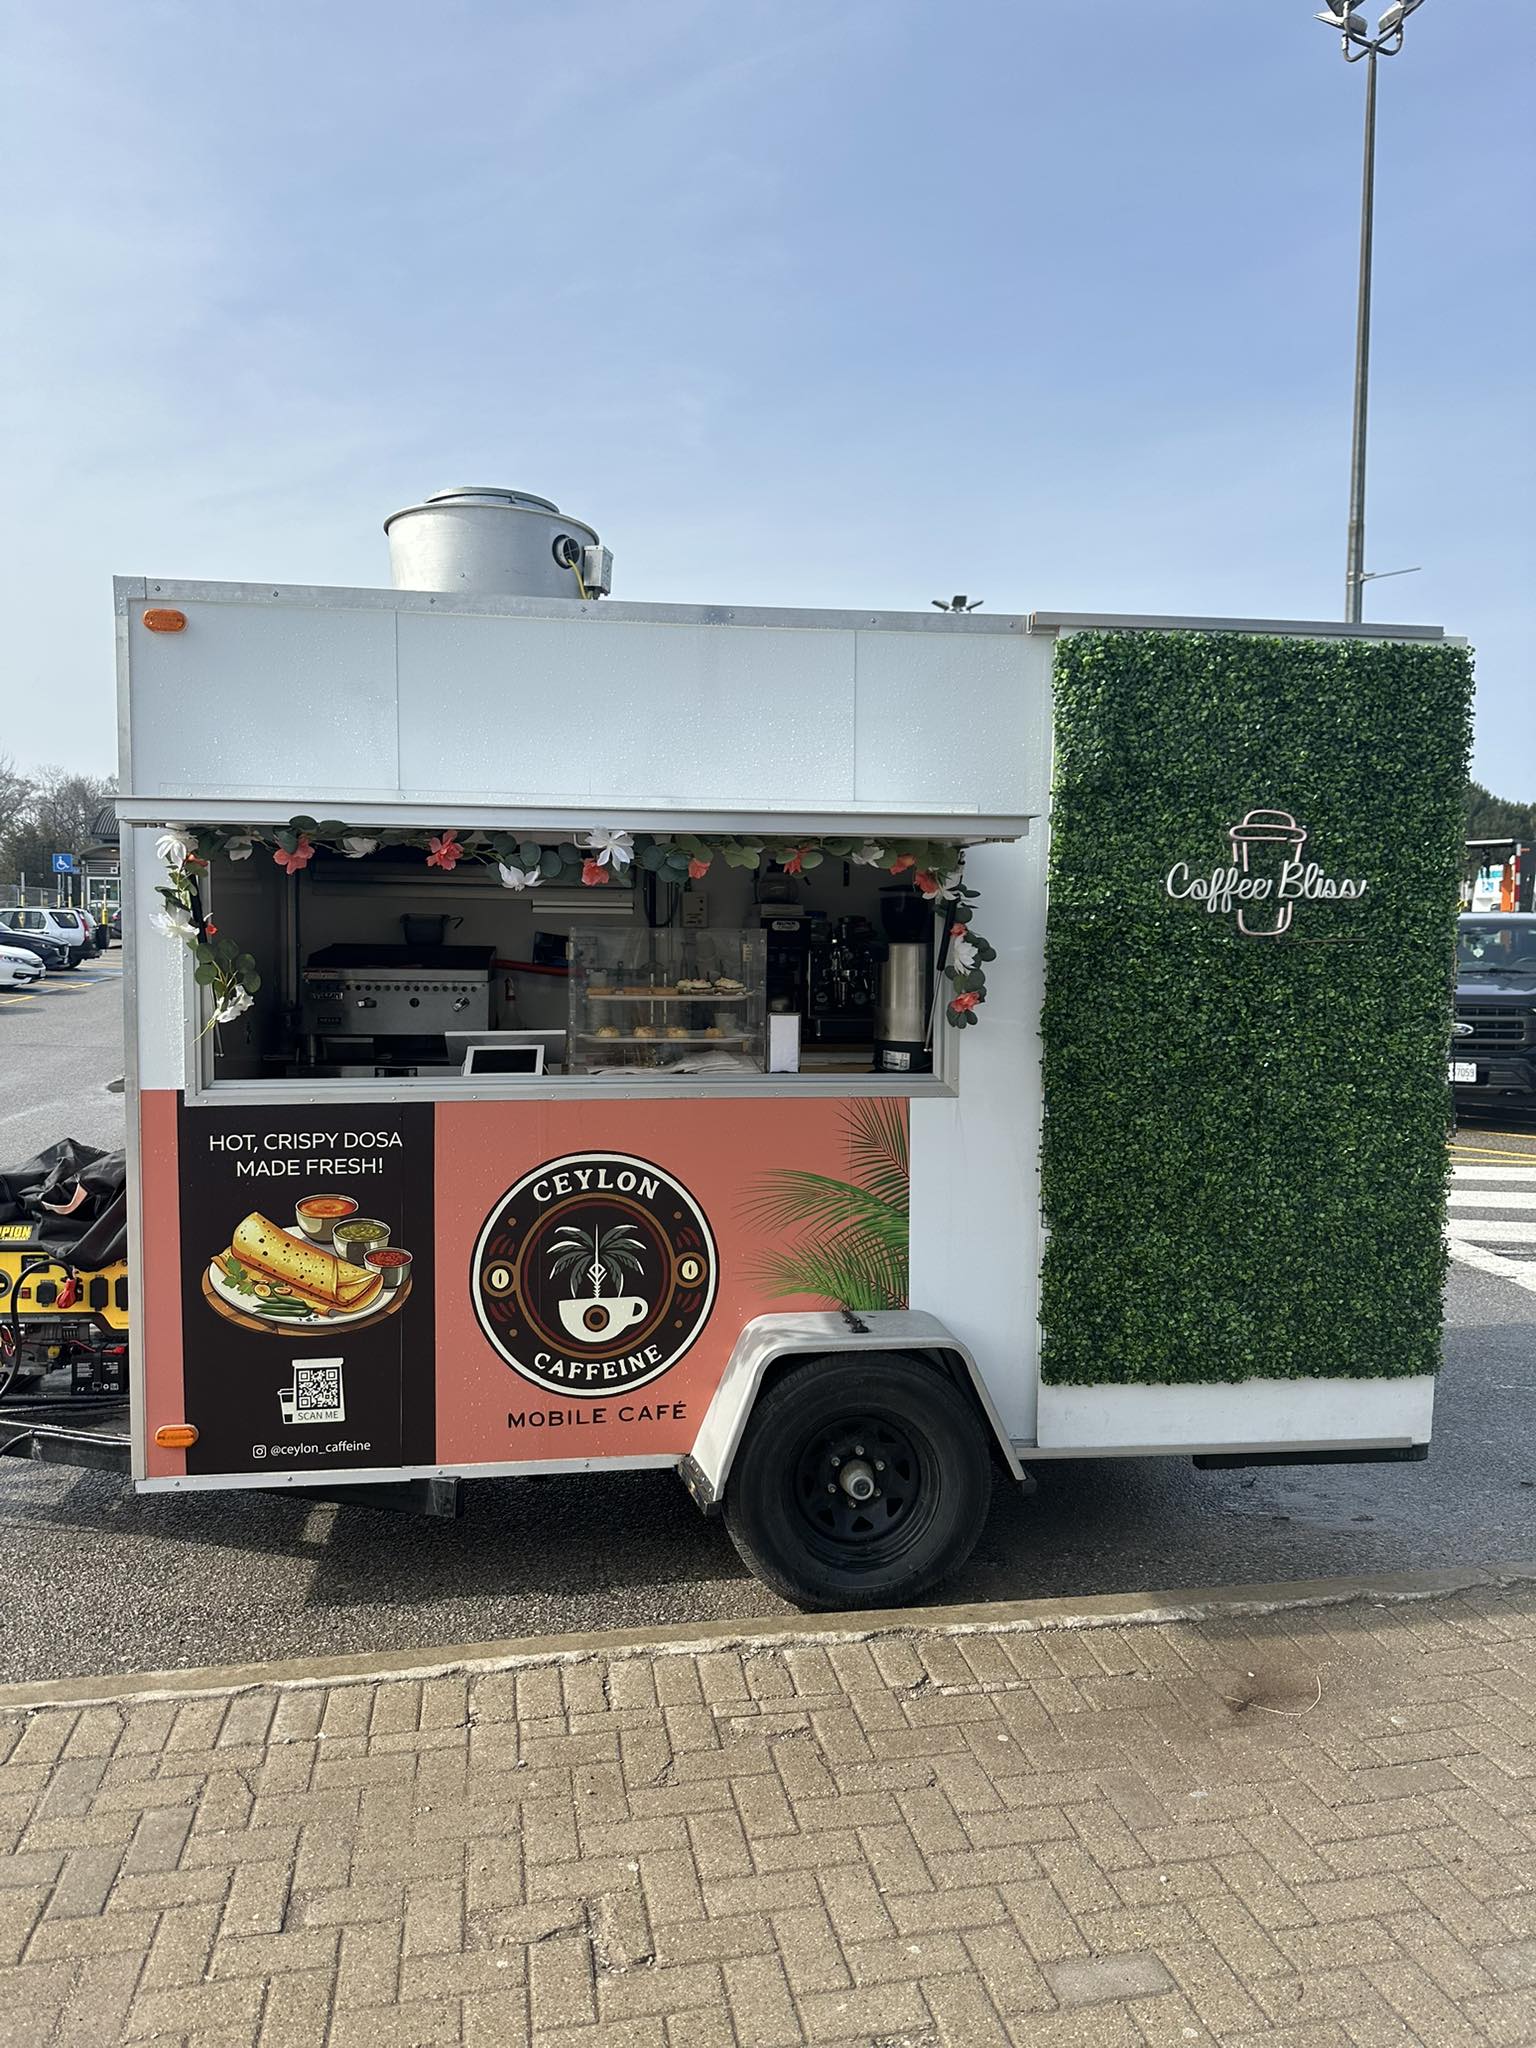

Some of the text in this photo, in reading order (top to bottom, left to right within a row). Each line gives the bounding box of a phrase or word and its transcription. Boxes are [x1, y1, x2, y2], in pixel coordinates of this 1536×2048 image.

[1167, 860, 1368, 914] Coffee Bliss
[1452, 1067, 1475, 1078] 7059
[209, 1131, 403, 1154] HOT, CRISPY DOSA
[236, 1157, 384, 1177] MADE FRESH!
[532, 1168, 661, 1203] CEYLON
[0, 1225, 33, 1238] PION
[533, 1343, 663, 1381] CAFFEINE
[297, 1410, 339, 1421] SCAN ME
[507, 1400, 688, 1429] MOBILE CAFÉ
[270, 1440, 372, 1457] @ceylon_caffeine
